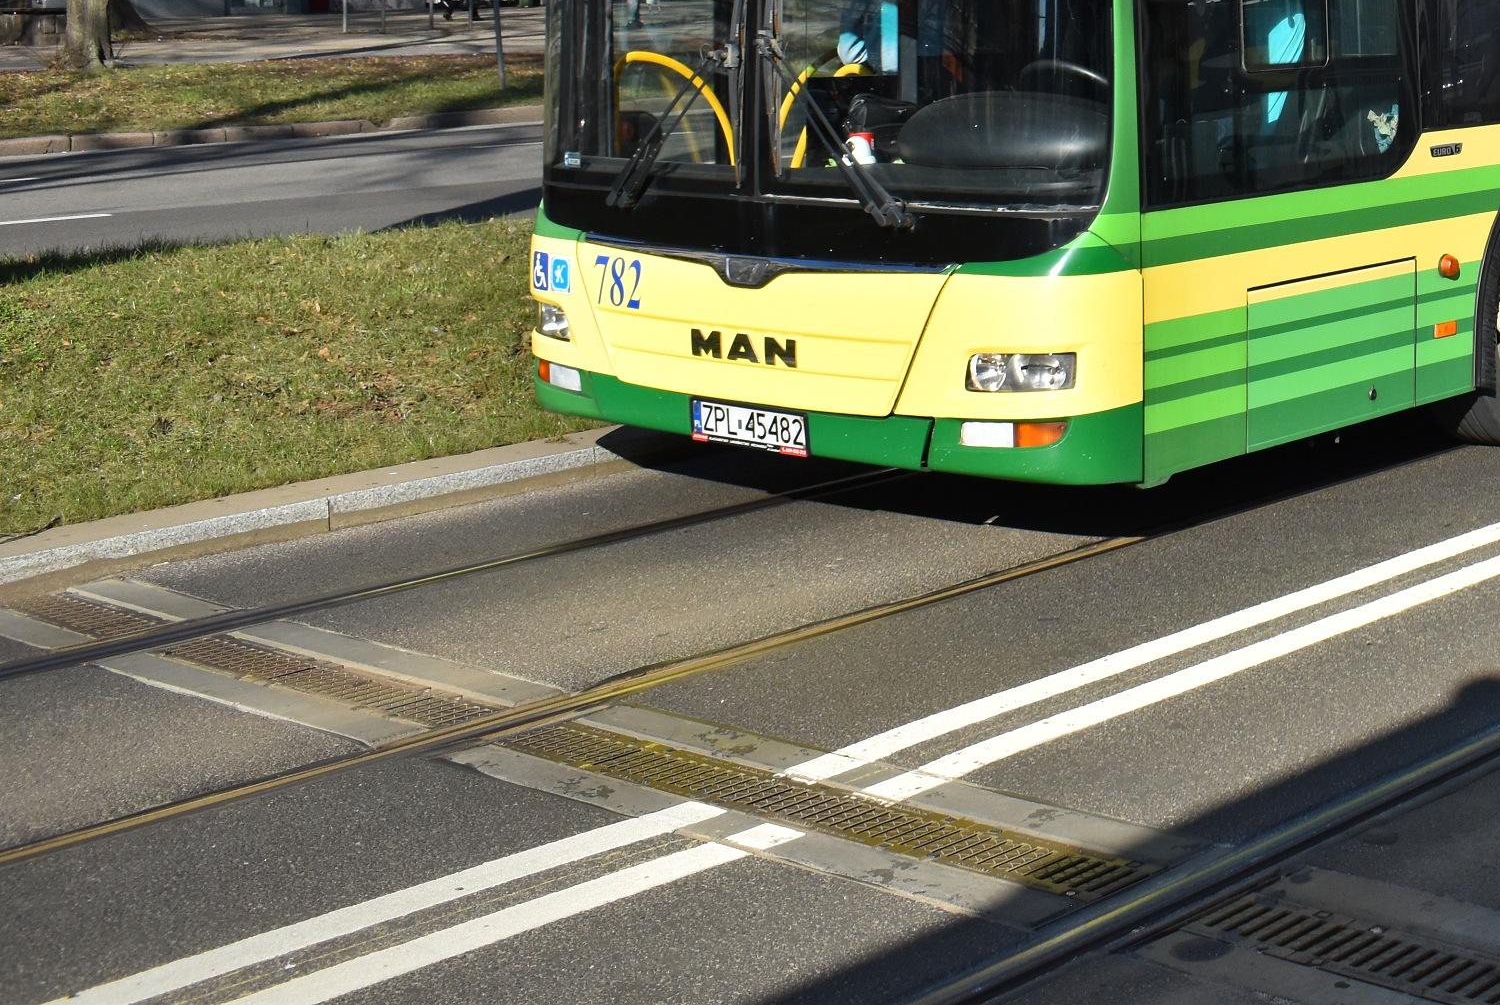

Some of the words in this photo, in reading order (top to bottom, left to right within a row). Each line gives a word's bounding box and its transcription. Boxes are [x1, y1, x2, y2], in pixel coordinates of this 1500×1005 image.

[1433, 147, 1451, 157] EURO
[594, 254, 642, 309] 782
[690, 328, 797, 369] MAN
[694, 419, 702, 428] PL
[702, 404, 738, 436] ZPL
[745, 411, 805, 445] 45482
